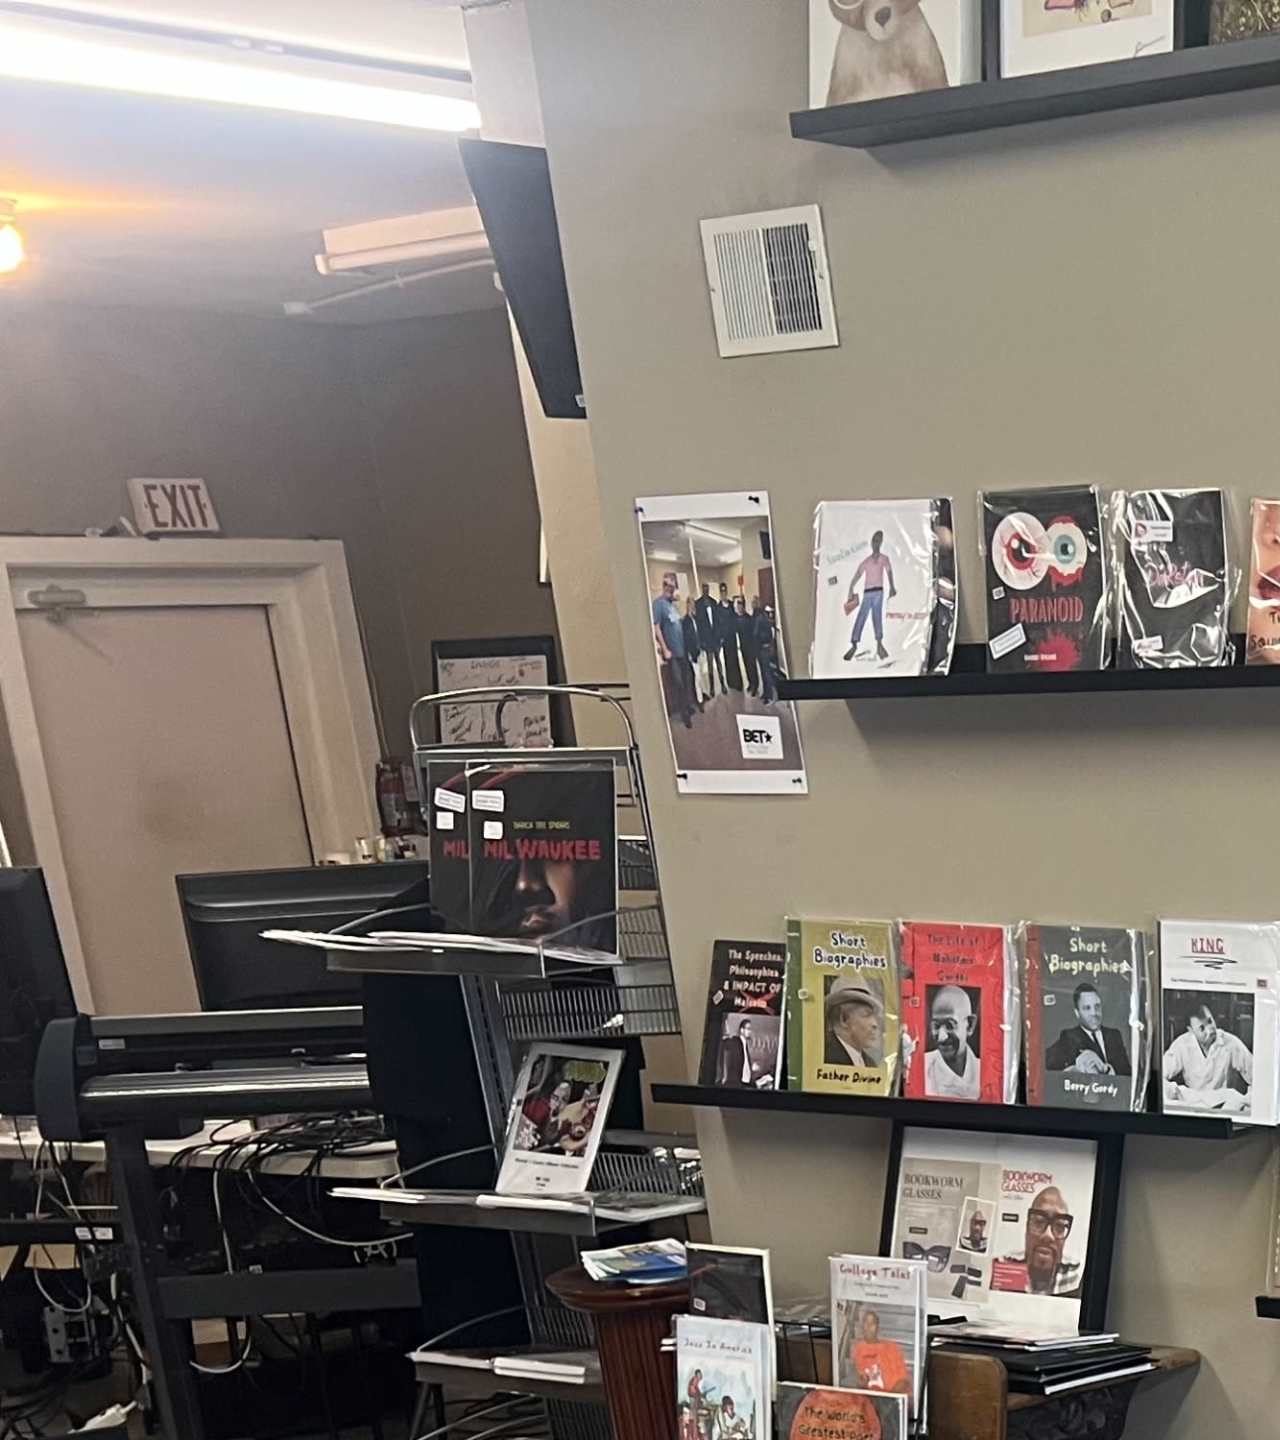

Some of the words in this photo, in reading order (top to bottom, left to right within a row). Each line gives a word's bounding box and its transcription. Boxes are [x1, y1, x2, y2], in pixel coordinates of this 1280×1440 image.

[143, 482, 207, 531] EXIT
[1008, 595, 1085, 625] PARANOID
[743, 728, 766, 745] BET
[484, 838, 600, 861] MILWAUKEE
[831, 931, 867, 949] Short
[1069, 937, 1107, 953] Short
[1190, 937, 1225, 953] KING
[728, 949, 742, 961] The
[813, 948, 888, 970] Biographies
[1049, 953, 1128, 977] Biographies
[731, 980, 767, 993] IMPACT
[769, 982, 783, 994] OF
[816, 1068, 850, 1085] Father
[852, 1070, 882, 1085] Divine
[1063, 1079, 1091, 1095] Berry
[1091, 1081, 1119, 1097] Gordy
[904, 1172, 964, 1189] BOOKWORM
[903, 1187, 943, 1201] GLASSES
[803, 1406, 823, 1419] The
[799, 1423, 846, 1440] Greatest
